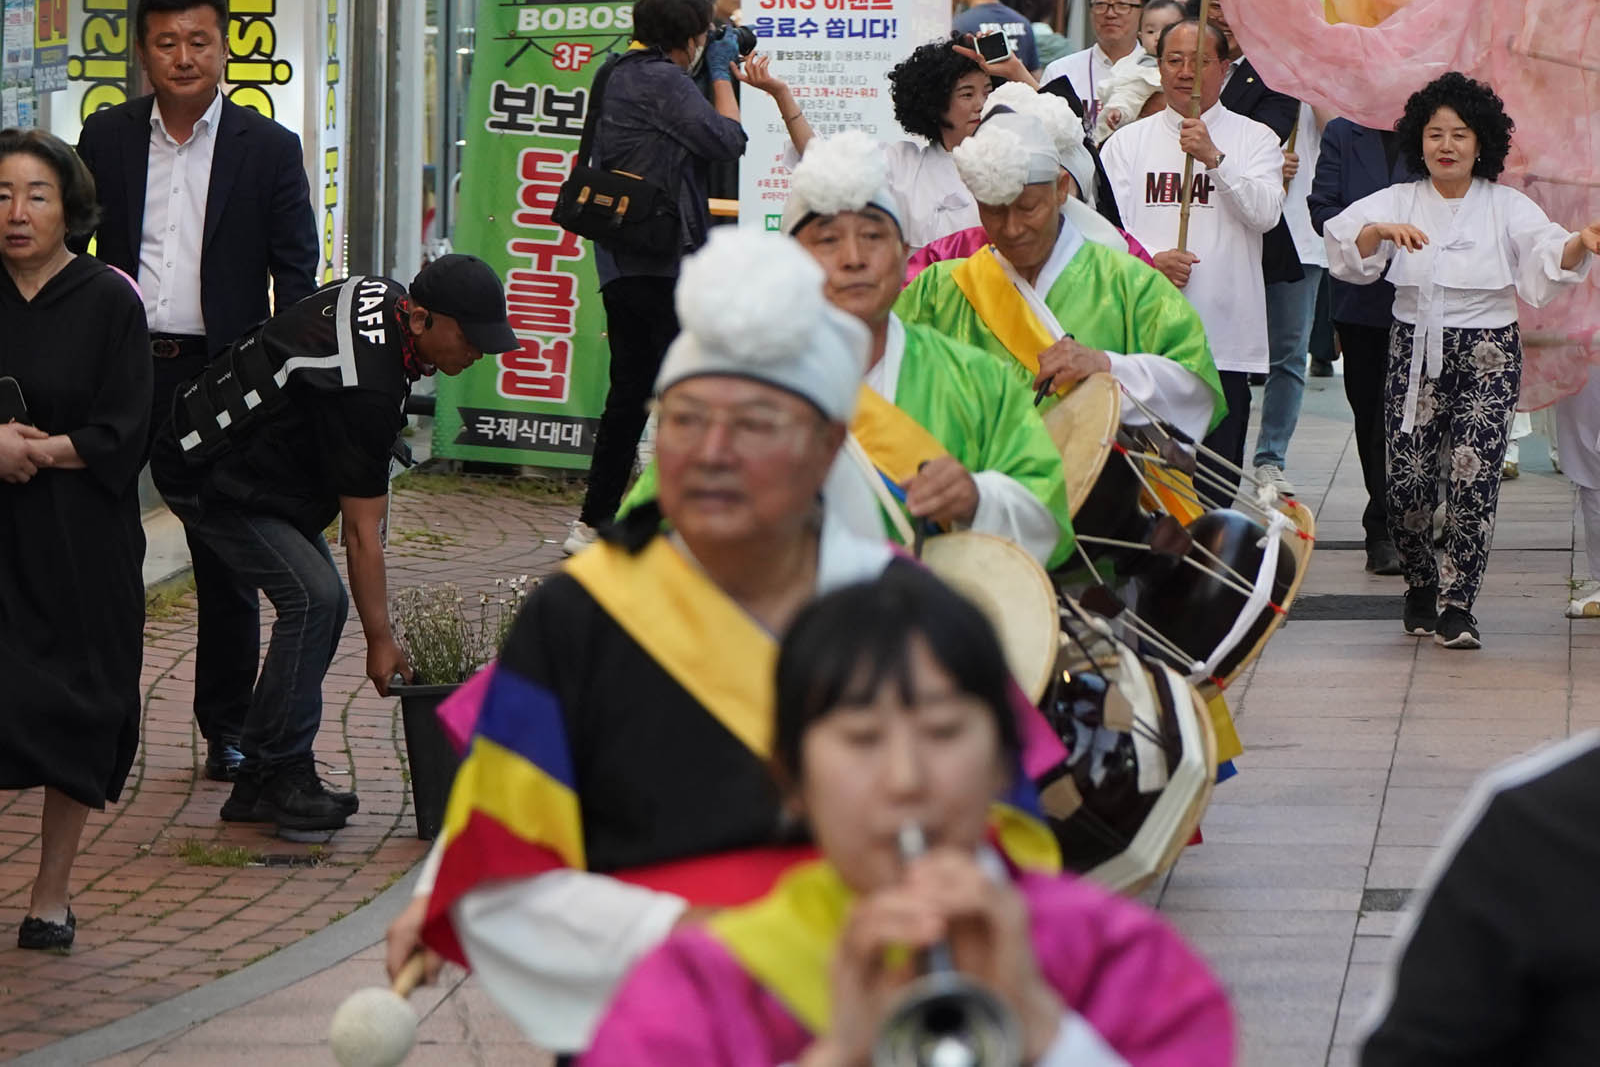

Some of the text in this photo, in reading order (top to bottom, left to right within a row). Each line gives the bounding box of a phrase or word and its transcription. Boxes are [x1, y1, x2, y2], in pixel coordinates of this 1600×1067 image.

[517, 4, 635, 32] BOBOS
[755, 16, 897, 40] 음료수 쏩니다!
[553, 43, 593, 72] 3F
[357, 280, 388, 345] STAFF
[474, 415, 584, 448] 국제식대대
